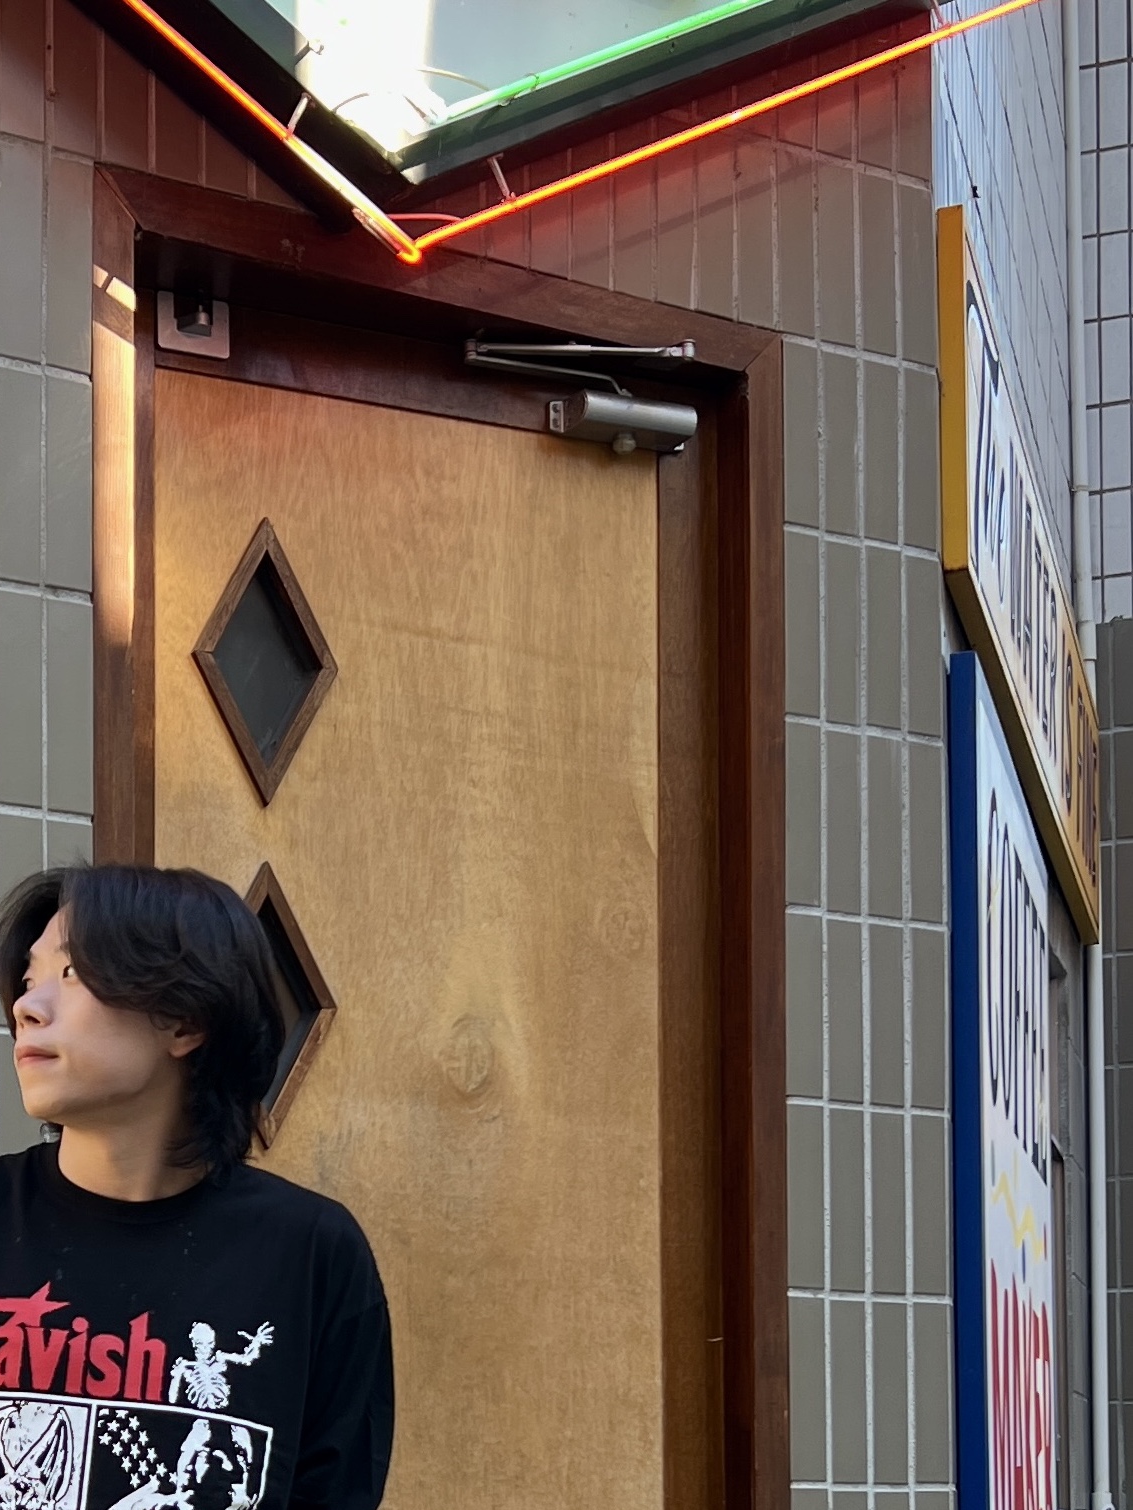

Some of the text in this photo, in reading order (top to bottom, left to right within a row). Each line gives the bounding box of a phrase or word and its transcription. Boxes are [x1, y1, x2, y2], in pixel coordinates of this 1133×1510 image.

[967, 280, 1097, 886] The WATER IS FINE
[987, 787, 1047, 1186] COFFEE
